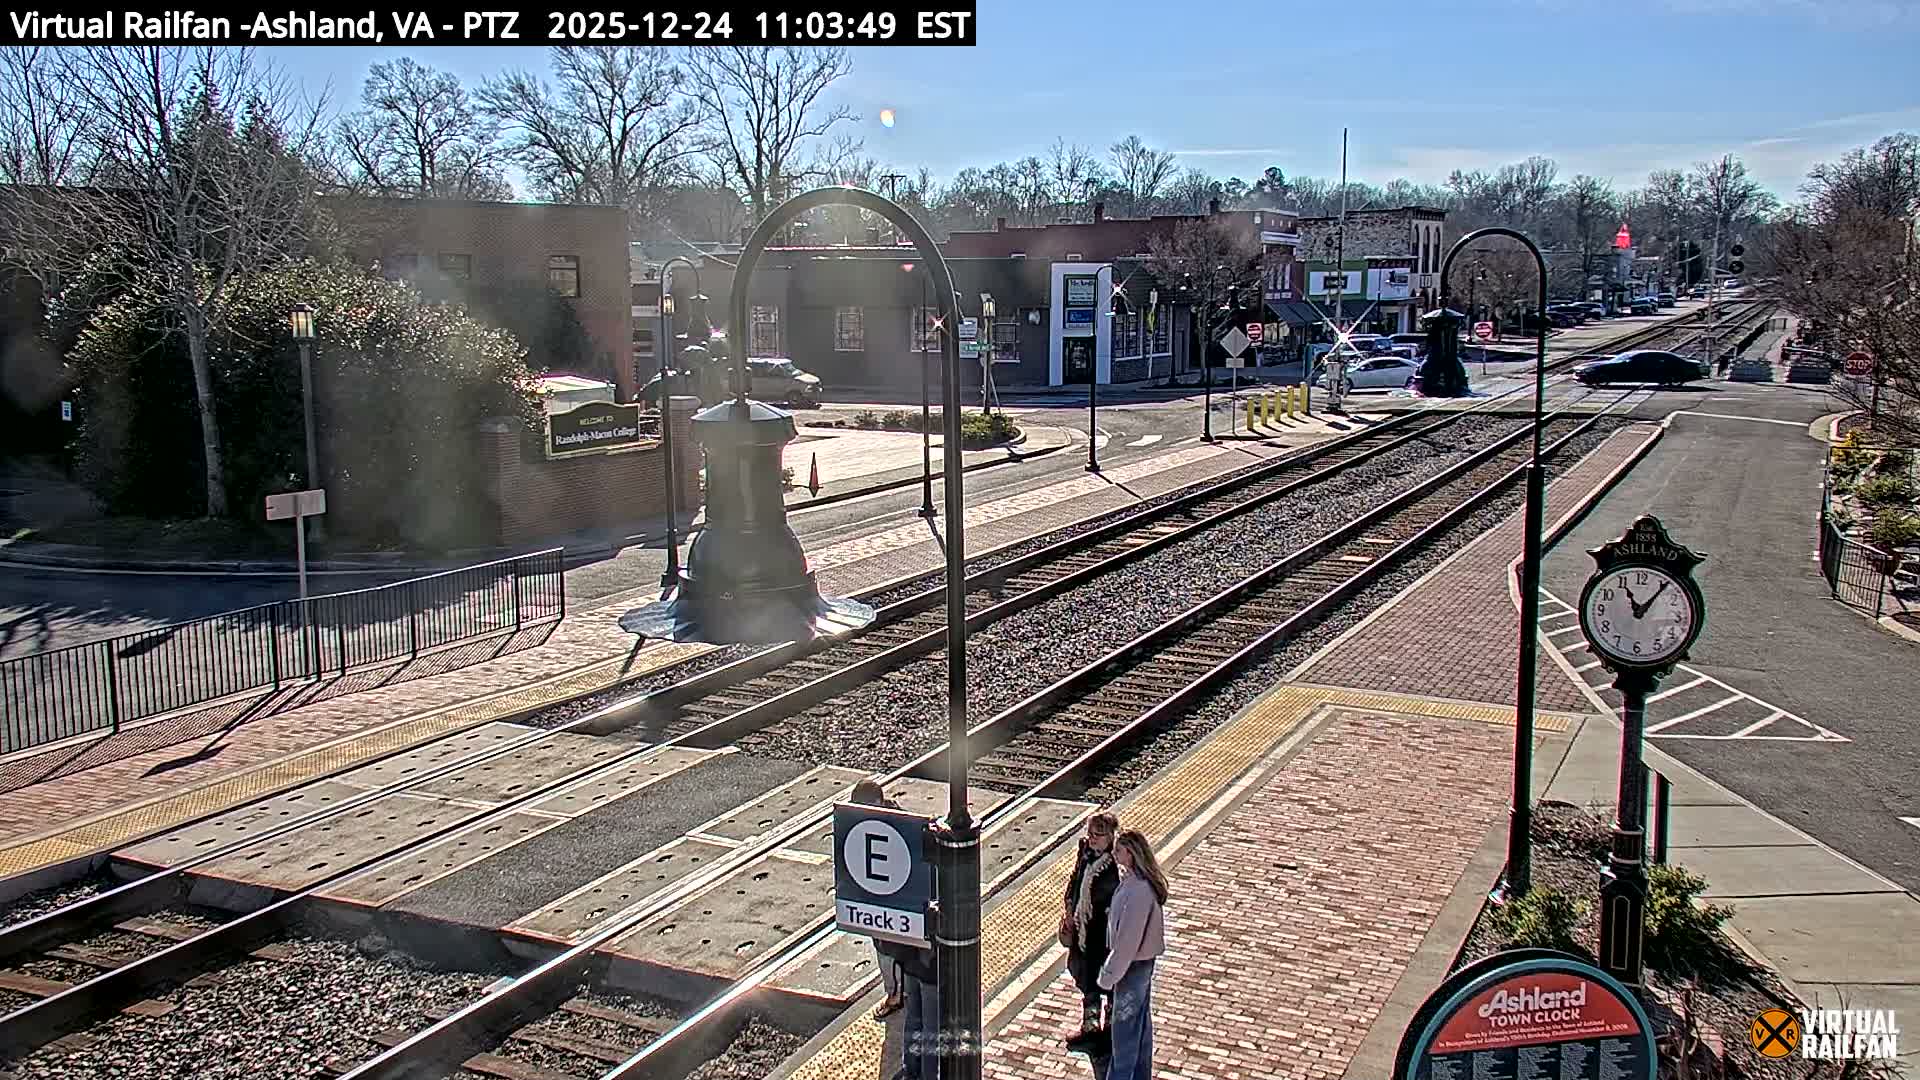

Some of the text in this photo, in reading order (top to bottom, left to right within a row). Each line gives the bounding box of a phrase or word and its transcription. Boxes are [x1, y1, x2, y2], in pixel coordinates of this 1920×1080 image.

[1846, 359, 1871, 370] STOP
[1614, 543, 1678, 561] ASHLAND
[1618, 577, 1628, 588] 11
[1635, 573, 1648, 586] 12
[1603, 589, 1615, 601] 10
[1670, 594, 1678, 606] 2
[1597, 604, 1605, 616] 9
[1675, 612, 1682, 623] 3
[1601, 620, 1611, 633] 8
[1668, 627, 1676, 640] 4
[1613, 635, 1621, 647] 7
[1633, 641, 1641, 654] 6
[1653, 638, 1663, 651] 5
[864, 832, 890, 882] E
[846, 904, 910, 932] Track 3
[1478, 981, 1586, 1018] Ashland
[1489, 1008, 1580, 1027] TOWN CLOCK
